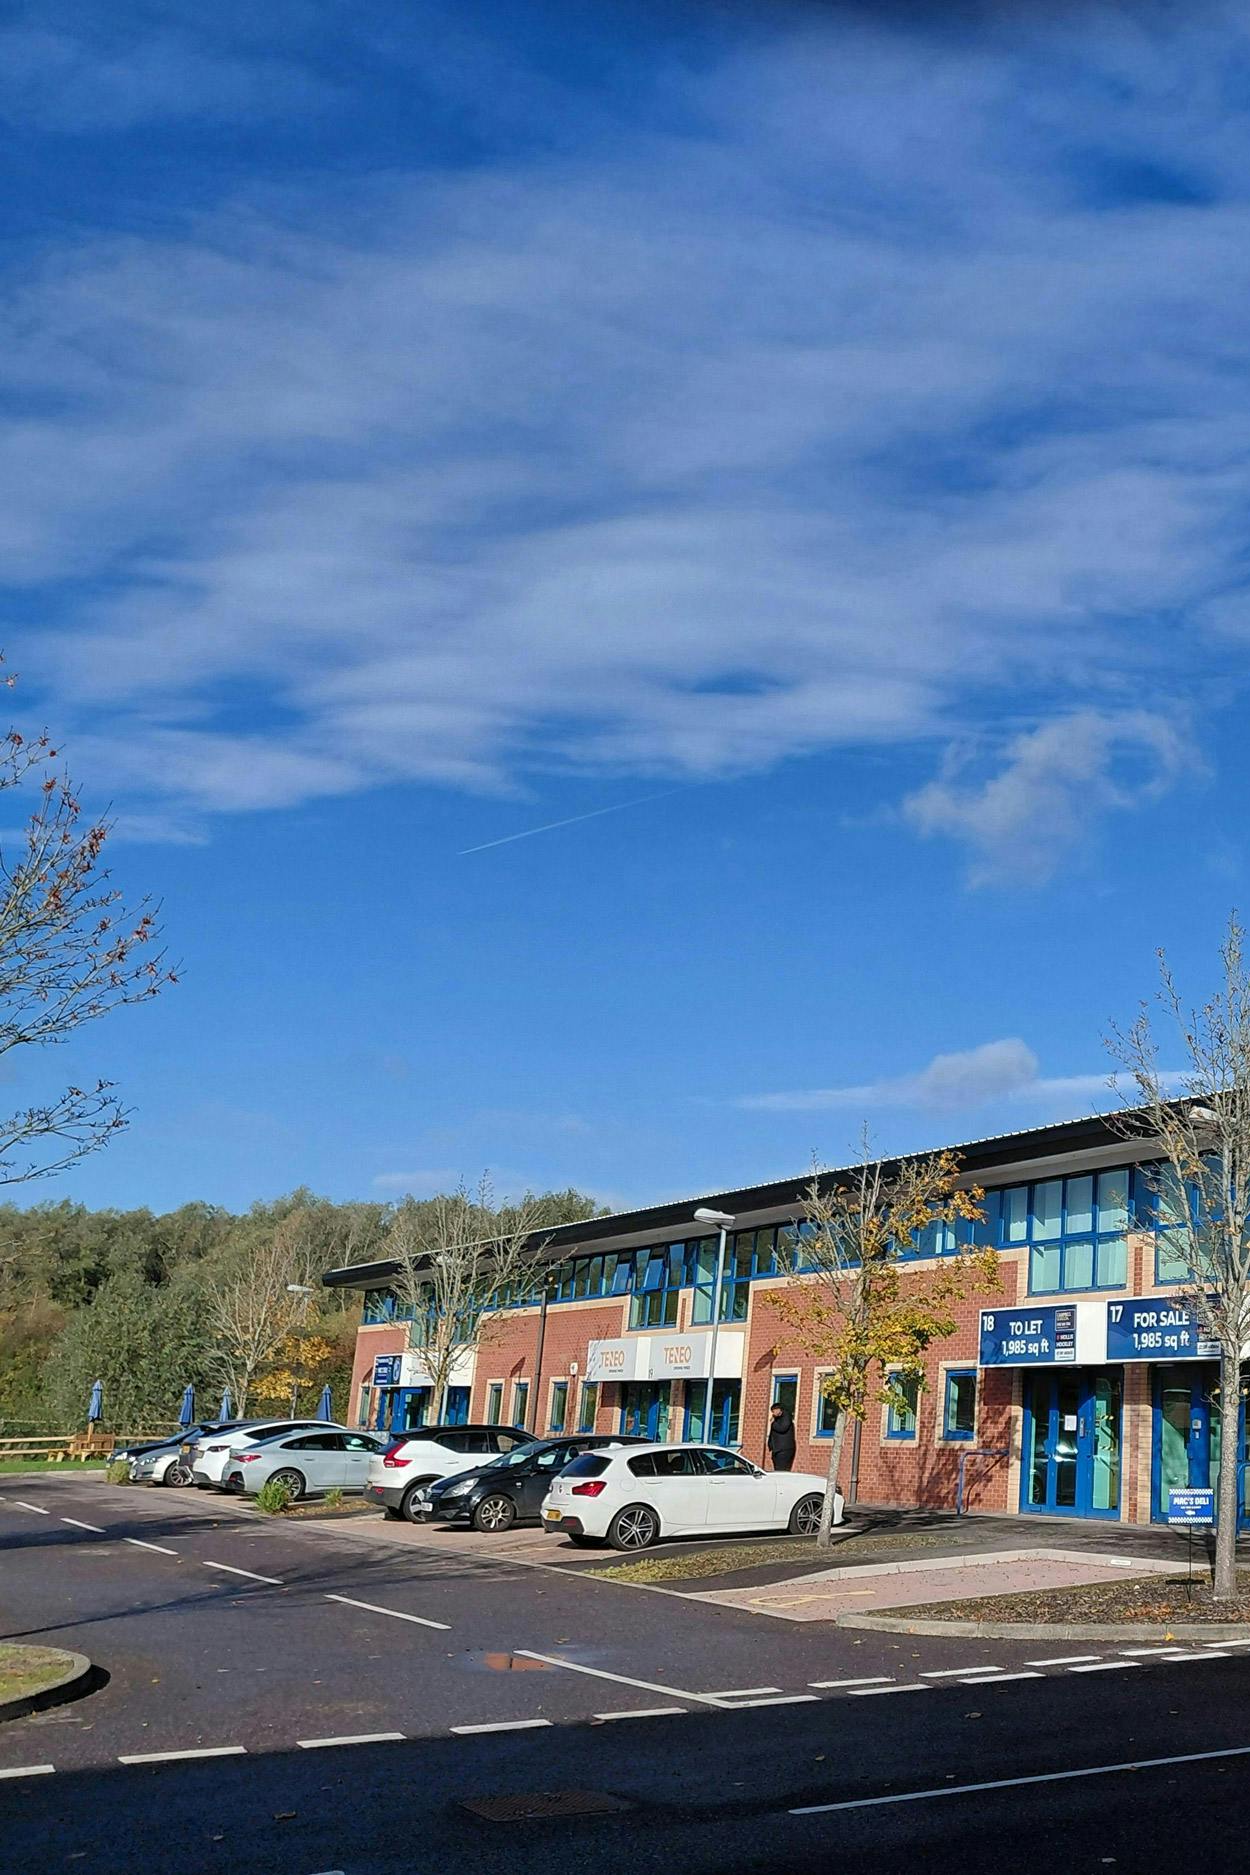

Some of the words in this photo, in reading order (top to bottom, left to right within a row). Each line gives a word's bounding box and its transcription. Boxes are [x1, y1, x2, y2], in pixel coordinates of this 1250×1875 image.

[1110, 1305, 1123, 1323] 17
[1134, 1312, 1157, 1328] FOR
[1160, 1311, 1190, 1327] SALE
[982, 1315, 995, 1332] 18
[1009, 1321, 1023, 1336] TO
[1024, 1320, 1043, 1335] LET
[1001, 1340, 1026, 1357] 1,985
[1027, 1342, 1039, 1356] sq
[1041, 1338, 1049, 1353] ft
[1133, 1332, 1162, 1351] 1,985
[1164, 1335, 1178, 1351] sq
[1180, 1330, 1190, 1346] ft
[600, 1350, 625, 1367] TENEO
[664, 1346, 692, 1364] TENEO
[1173, 1497, 1194, 1505] MAC'S
[1195, 1497, 1210, 1505] DELI
